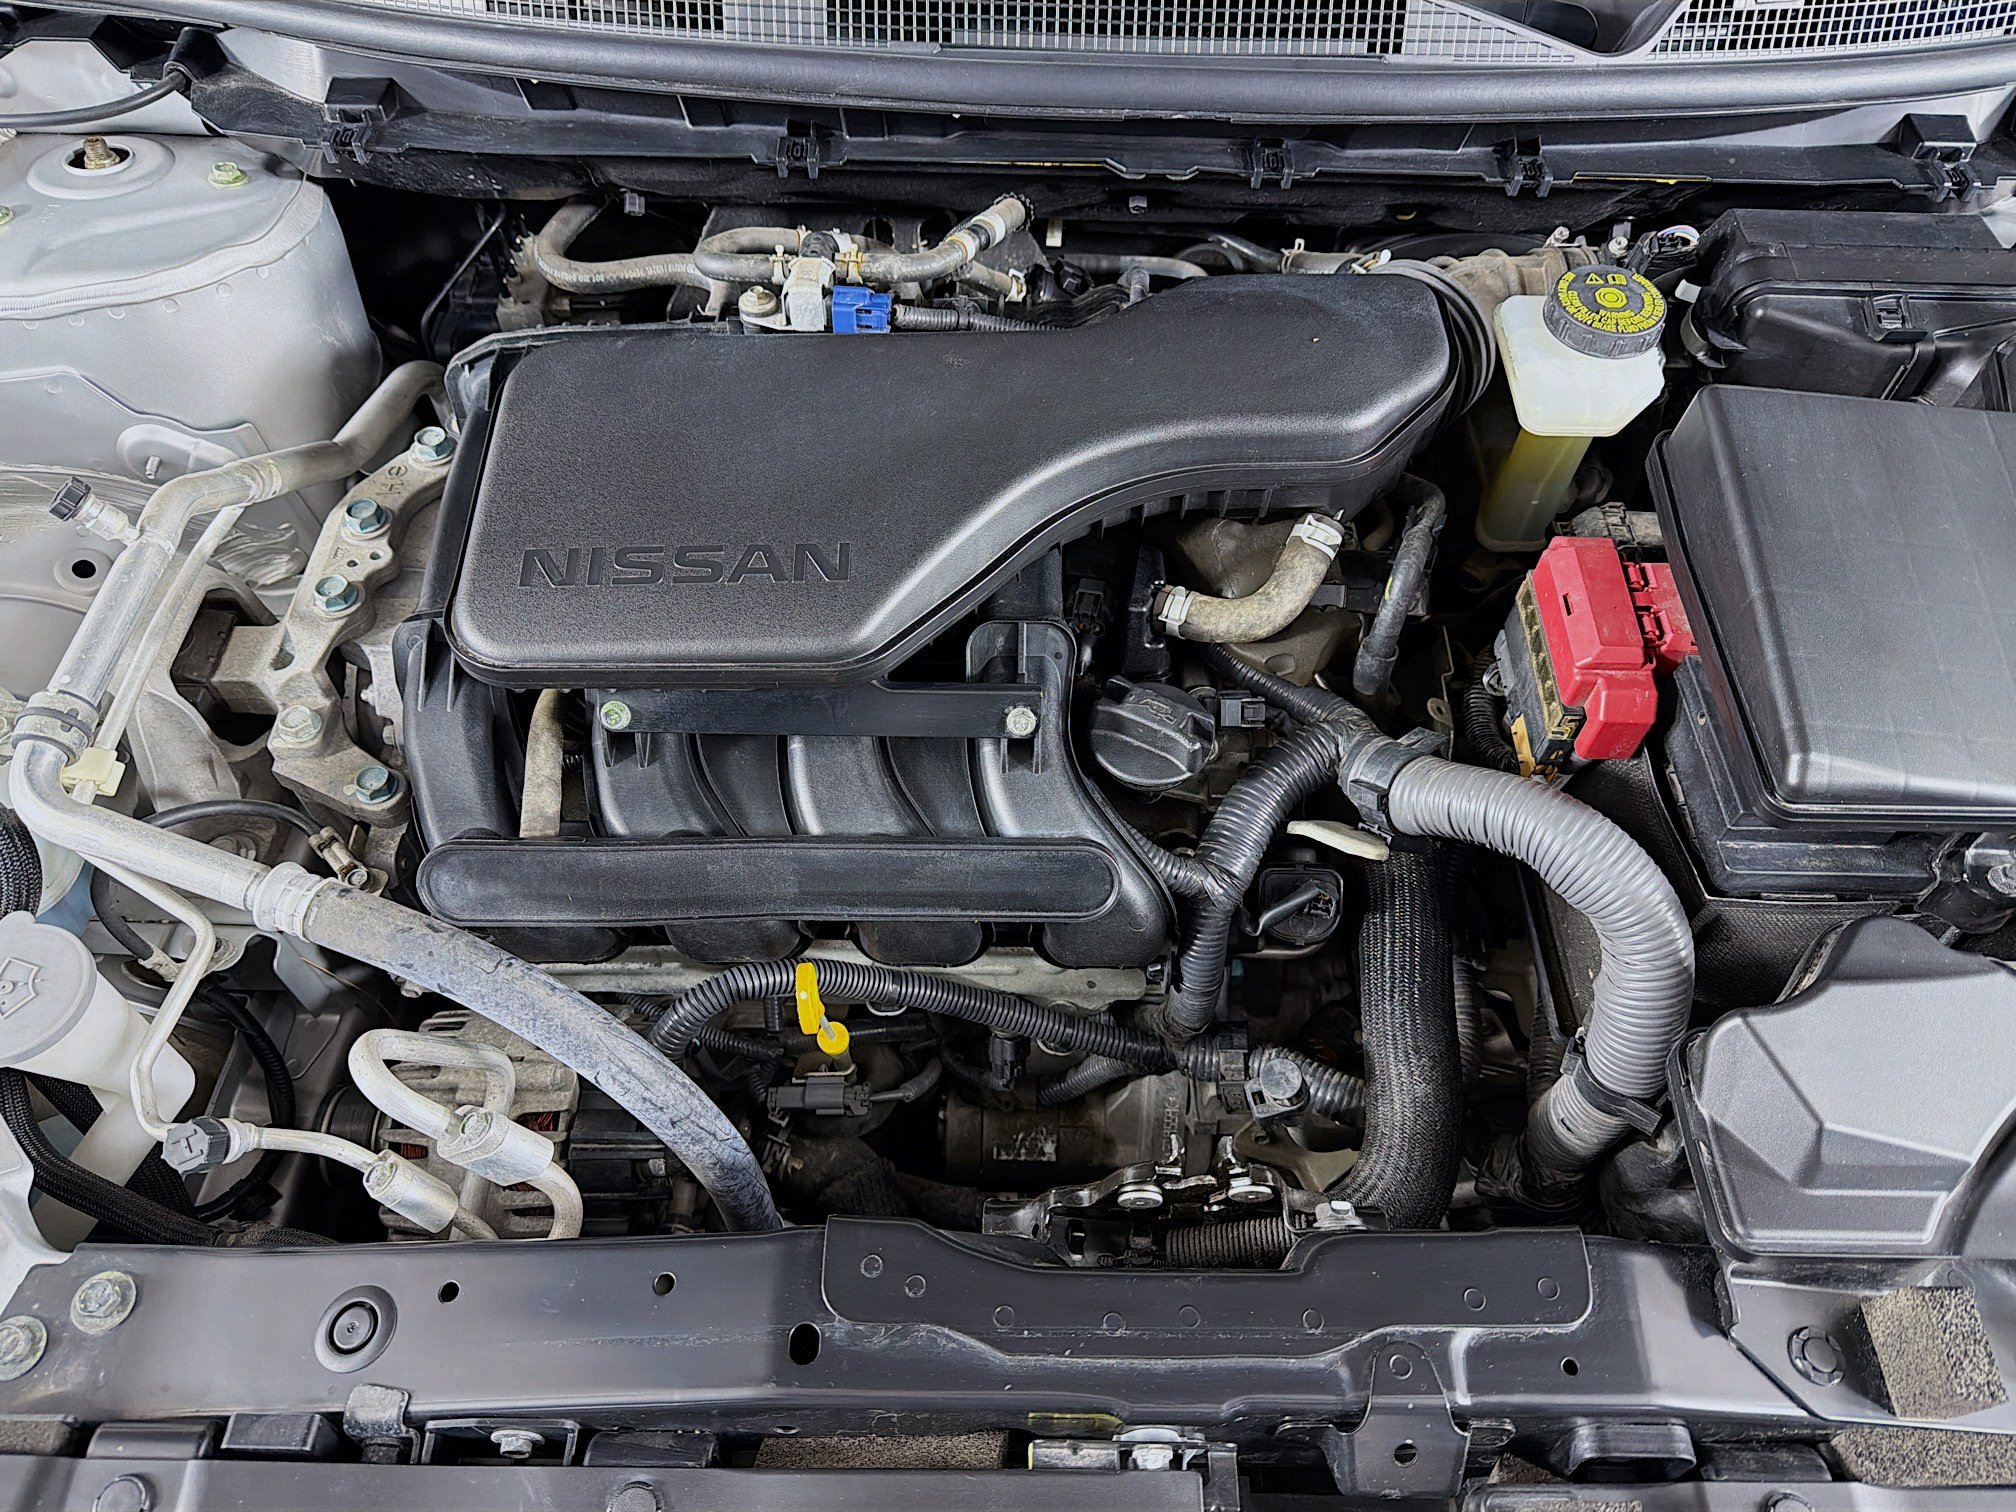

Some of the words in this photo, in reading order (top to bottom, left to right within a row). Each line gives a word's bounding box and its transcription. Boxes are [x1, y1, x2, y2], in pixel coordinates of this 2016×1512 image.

[1568, 290, 1582, 308] CLEAN
[1577, 305, 1601, 321] FILLER
[1601, 316, 1618, 326] CAP
[1618, 312, 1646, 326] BEFORE
[1599, 309, 1635, 319] WARNING
[1592, 320, 1618, 333] BRAKE
[1618, 323, 1640, 334] FLUID
[1638, 318, 1657, 330] FROM
[518, 541, 853, 588] NISSAN
